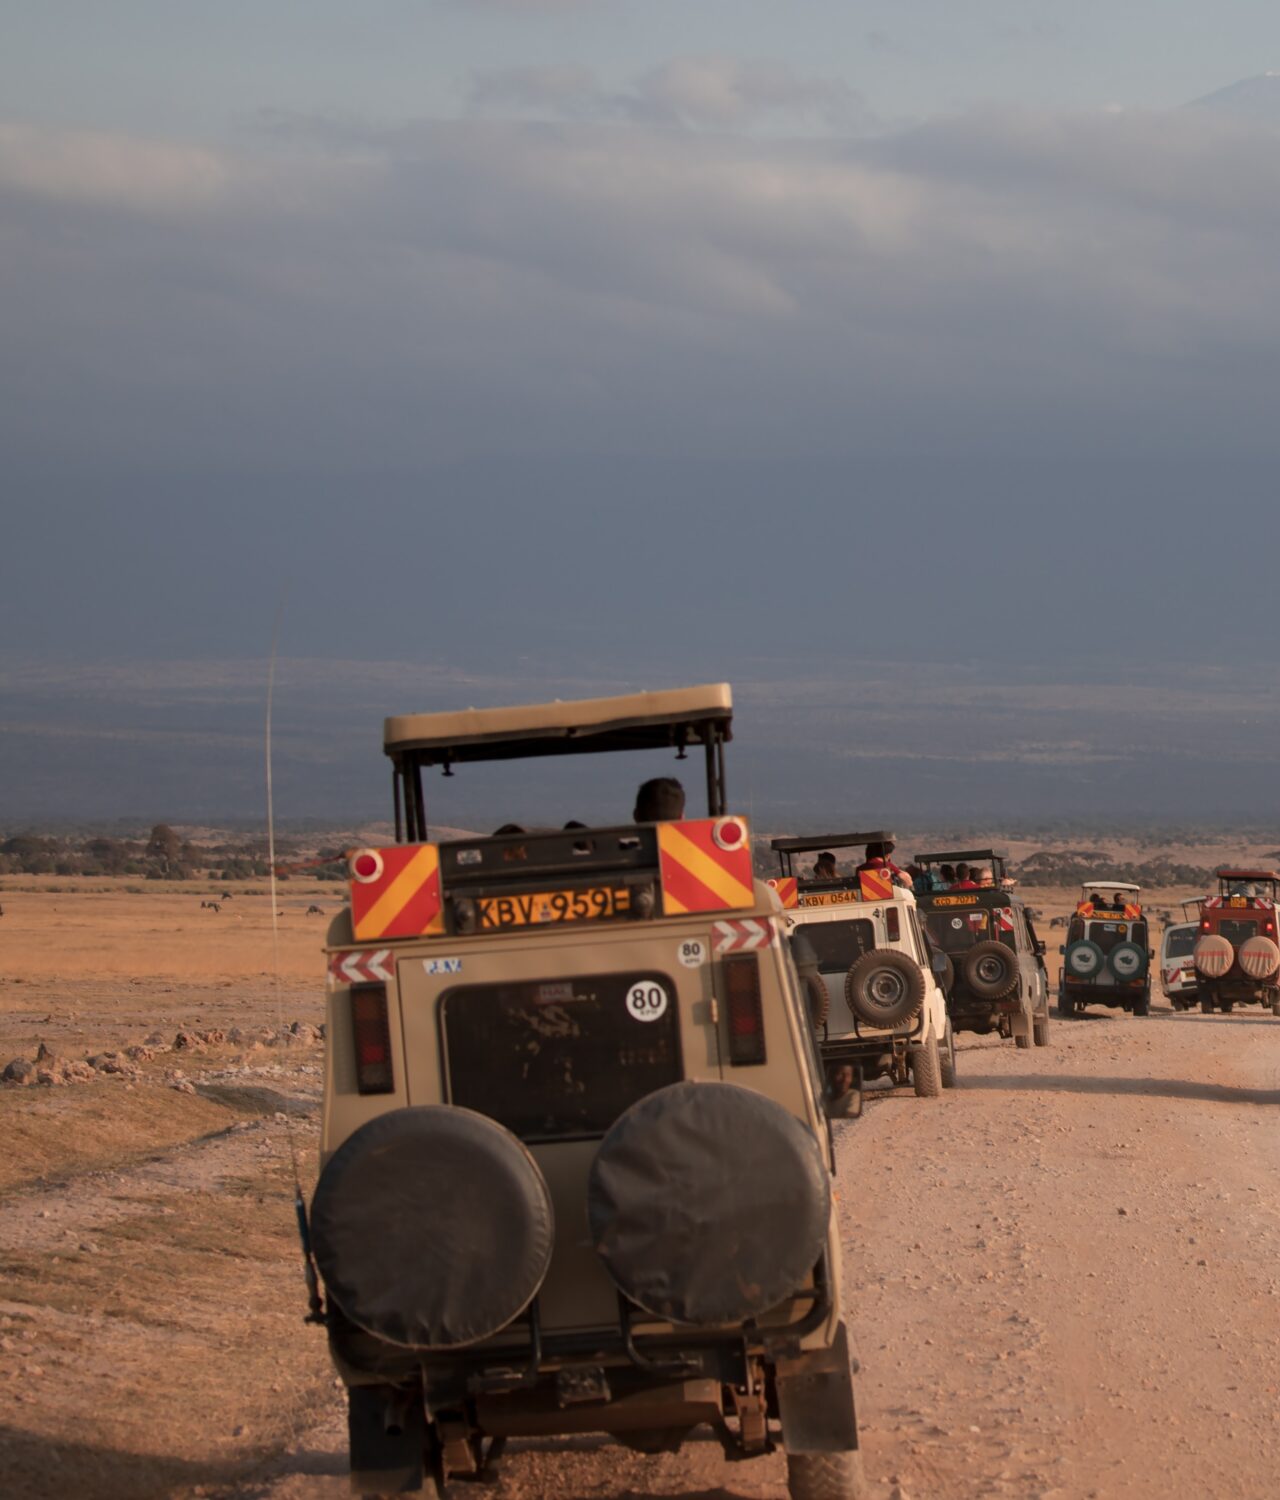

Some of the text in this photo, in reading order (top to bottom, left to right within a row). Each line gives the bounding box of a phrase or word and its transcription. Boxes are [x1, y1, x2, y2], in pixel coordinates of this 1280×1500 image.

[805, 891, 857, 907] KBV 054A
[478, 896, 535, 928] KBV
[682, 943, 700, 957] 80
[632, 987, 662, 1010] 80
